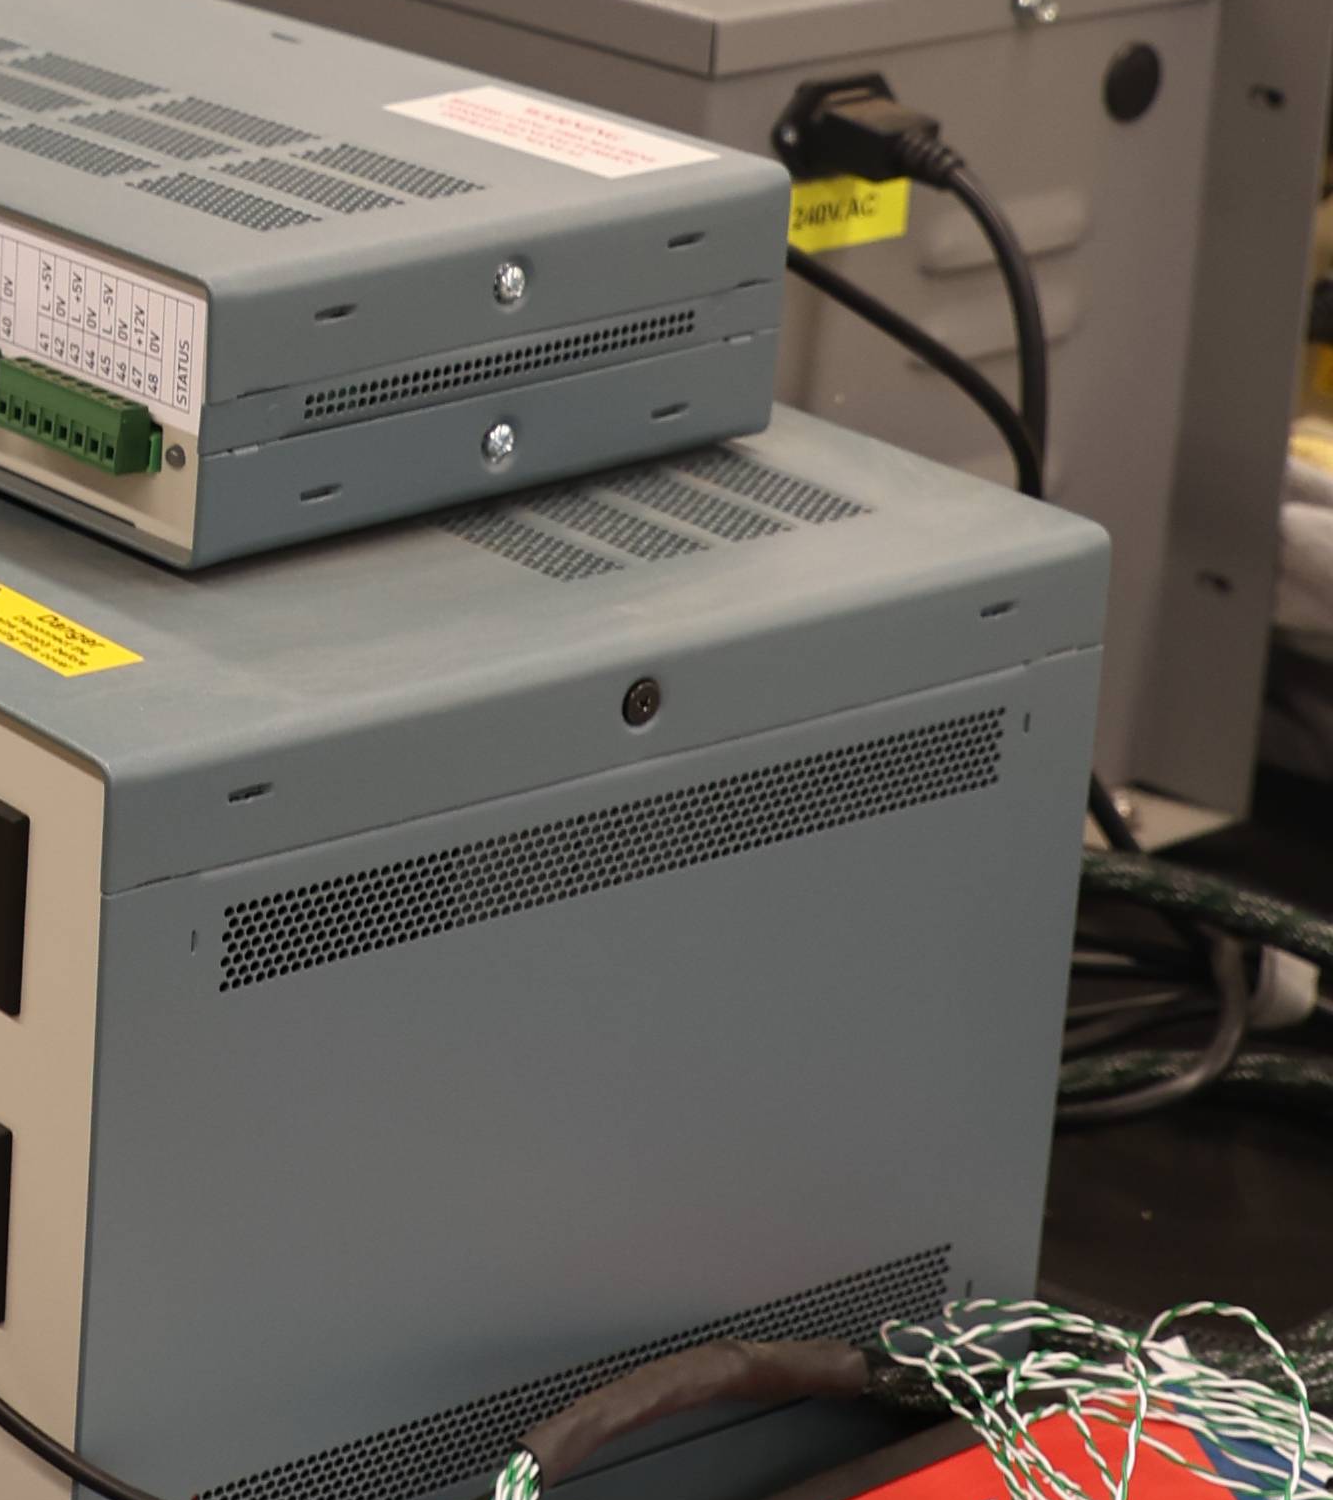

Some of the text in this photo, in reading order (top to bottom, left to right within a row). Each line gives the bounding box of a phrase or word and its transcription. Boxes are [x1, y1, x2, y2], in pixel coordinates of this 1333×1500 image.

[39, 261, 52, 352] 41 L +5V
[3, 316, 12, 337] 40
[69, 272, 82, 364] 43 L +5V
[103, 325, 112, 335] L
[54, 337, 65, 358] 42
[132, 304, 145, 389] 47 +12V
[85, 350, 95, 370] 44
[101, 355, 110, 376] 45
[116, 361, 126, 383] 46
[177, 339, 189, 406] STATUS
[148, 374, 158, 395] 48
[37, 615, 106, 648] Danger
